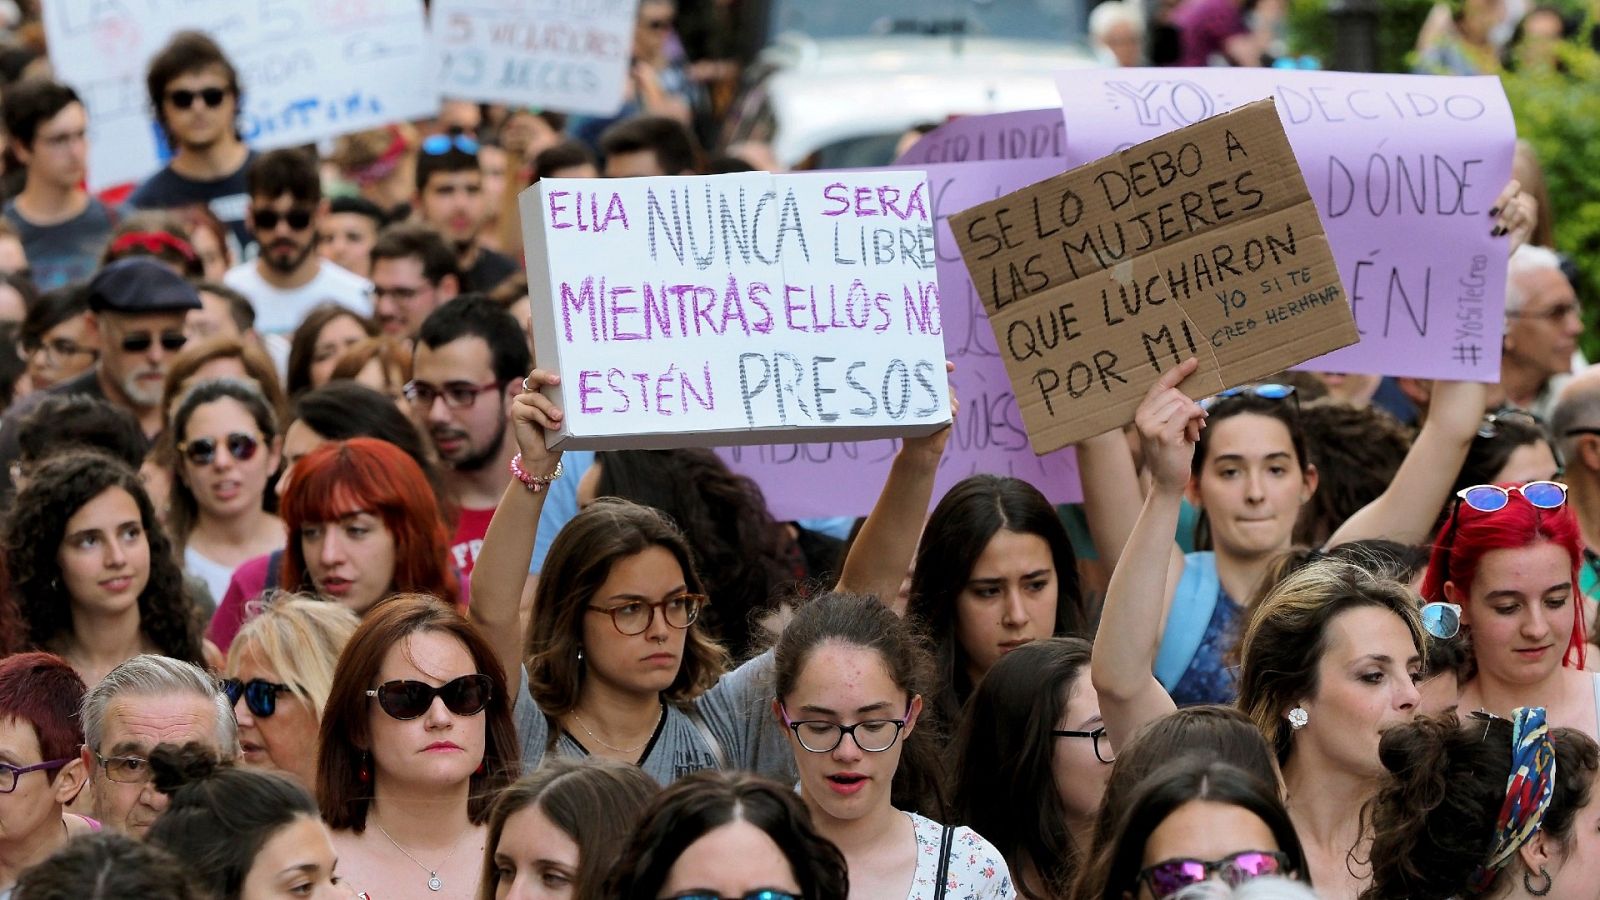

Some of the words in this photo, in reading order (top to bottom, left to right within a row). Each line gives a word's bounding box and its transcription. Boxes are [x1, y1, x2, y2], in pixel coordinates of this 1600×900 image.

[1104, 80, 1214, 128] YO
[1276, 85, 1485, 125] DECIDO
[968, 208, 1024, 260] SE
[1033, 188, 1083, 239] LO
[1093, 143, 1202, 211] DEBO
[1226, 129, 1247, 161] A
[1327, 137, 1484, 218] DÓNDE
[549, 190, 629, 232] ELLA
[647, 181, 810, 270] NUNCA
[834, 221, 936, 270] LIBRE
[992, 253, 1049, 310] LAS
[1062, 170, 1264, 280] MUJERES
[560, 272, 775, 343] MIENTRAS
[784, 278, 892, 333] ELLOS
[903, 280, 941, 335] NO
[1007, 302, 1081, 361] QUE
[1101, 223, 1296, 326] LUCHARON
[1216, 289, 1246, 317] YO
[1260, 277, 1283, 295] SI
[1287, 267, 1312, 286] TE
[1032, 350, 1127, 417] POR
[1141, 320, 1197, 374] MI
[1211, 319, 1256, 347] CREO
[578, 361, 715, 416] ESTÉN
[739, 350, 940, 425] PRESOS
